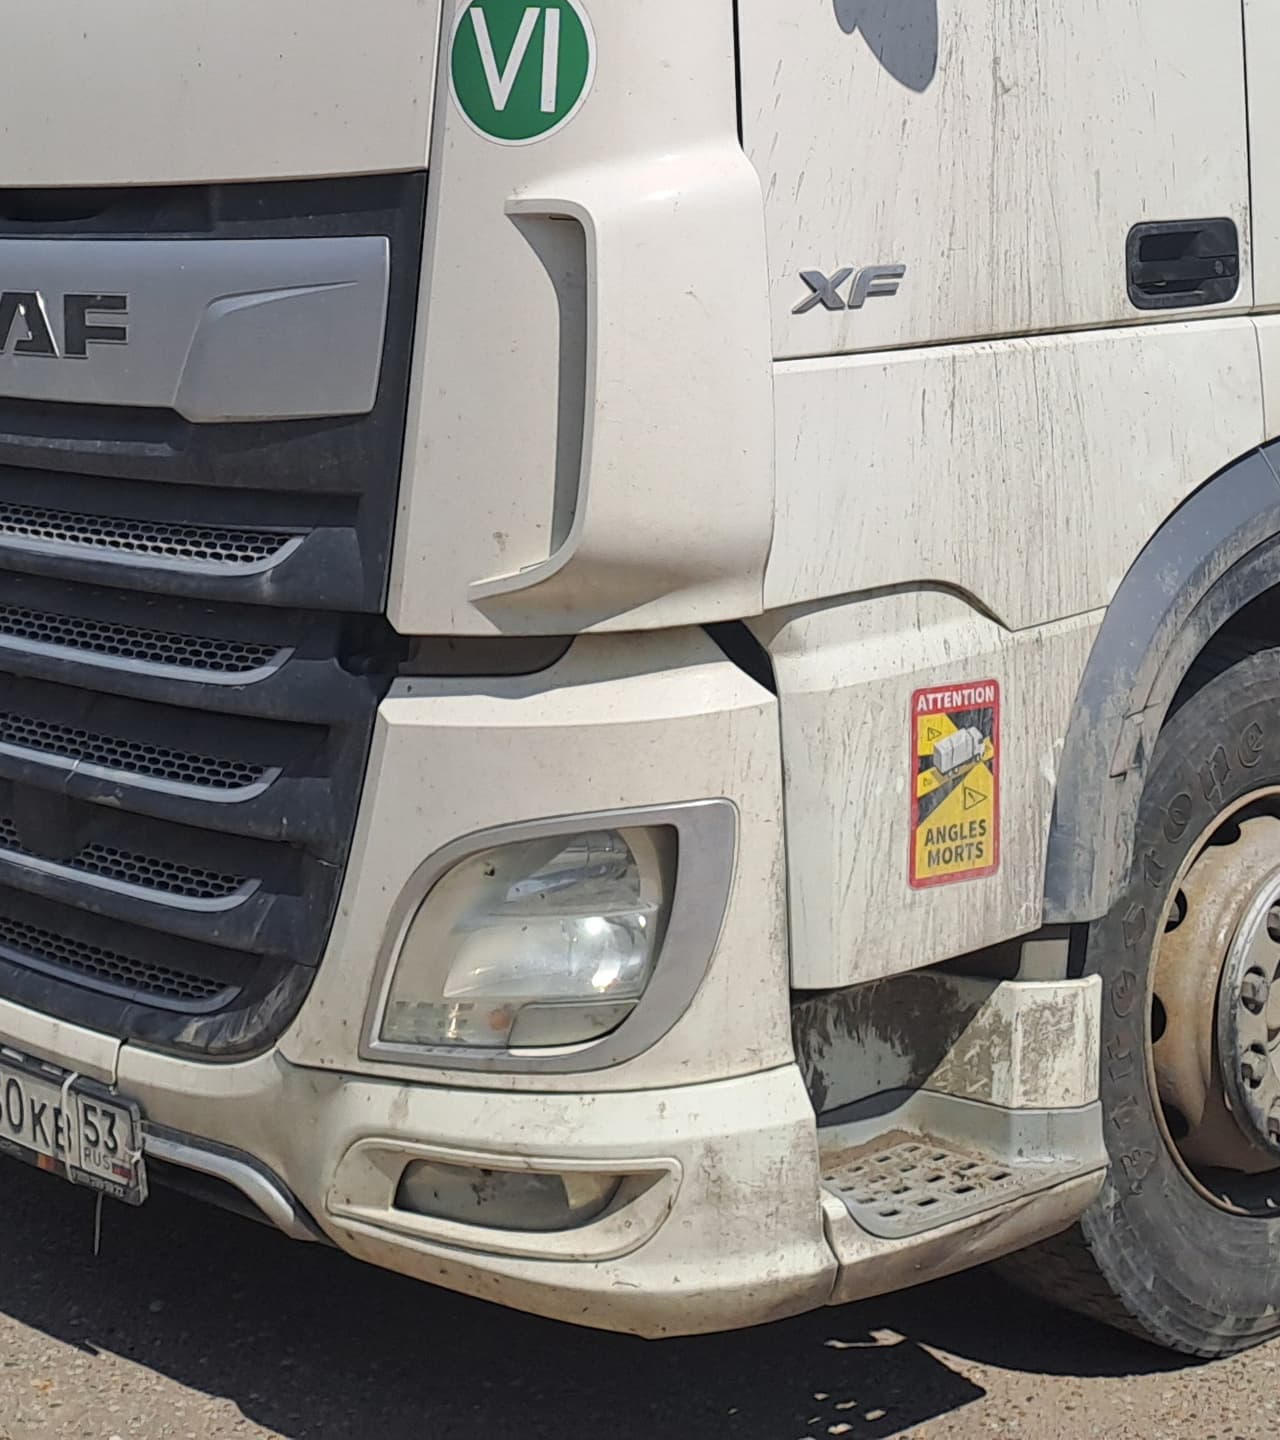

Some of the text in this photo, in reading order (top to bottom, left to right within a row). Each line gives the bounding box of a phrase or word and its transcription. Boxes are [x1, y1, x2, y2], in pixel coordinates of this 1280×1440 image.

[468, 6, 560, 113] VI
[791, 264, 907, 315] XF
[916, 685, 996, 713] ATTENTION
[924, 818, 987, 847] ANGLES
[927, 841, 984, 868] MORTS
[82, 1103, 119, 1154] 53
[83, 1146, 112, 1170] RUS
